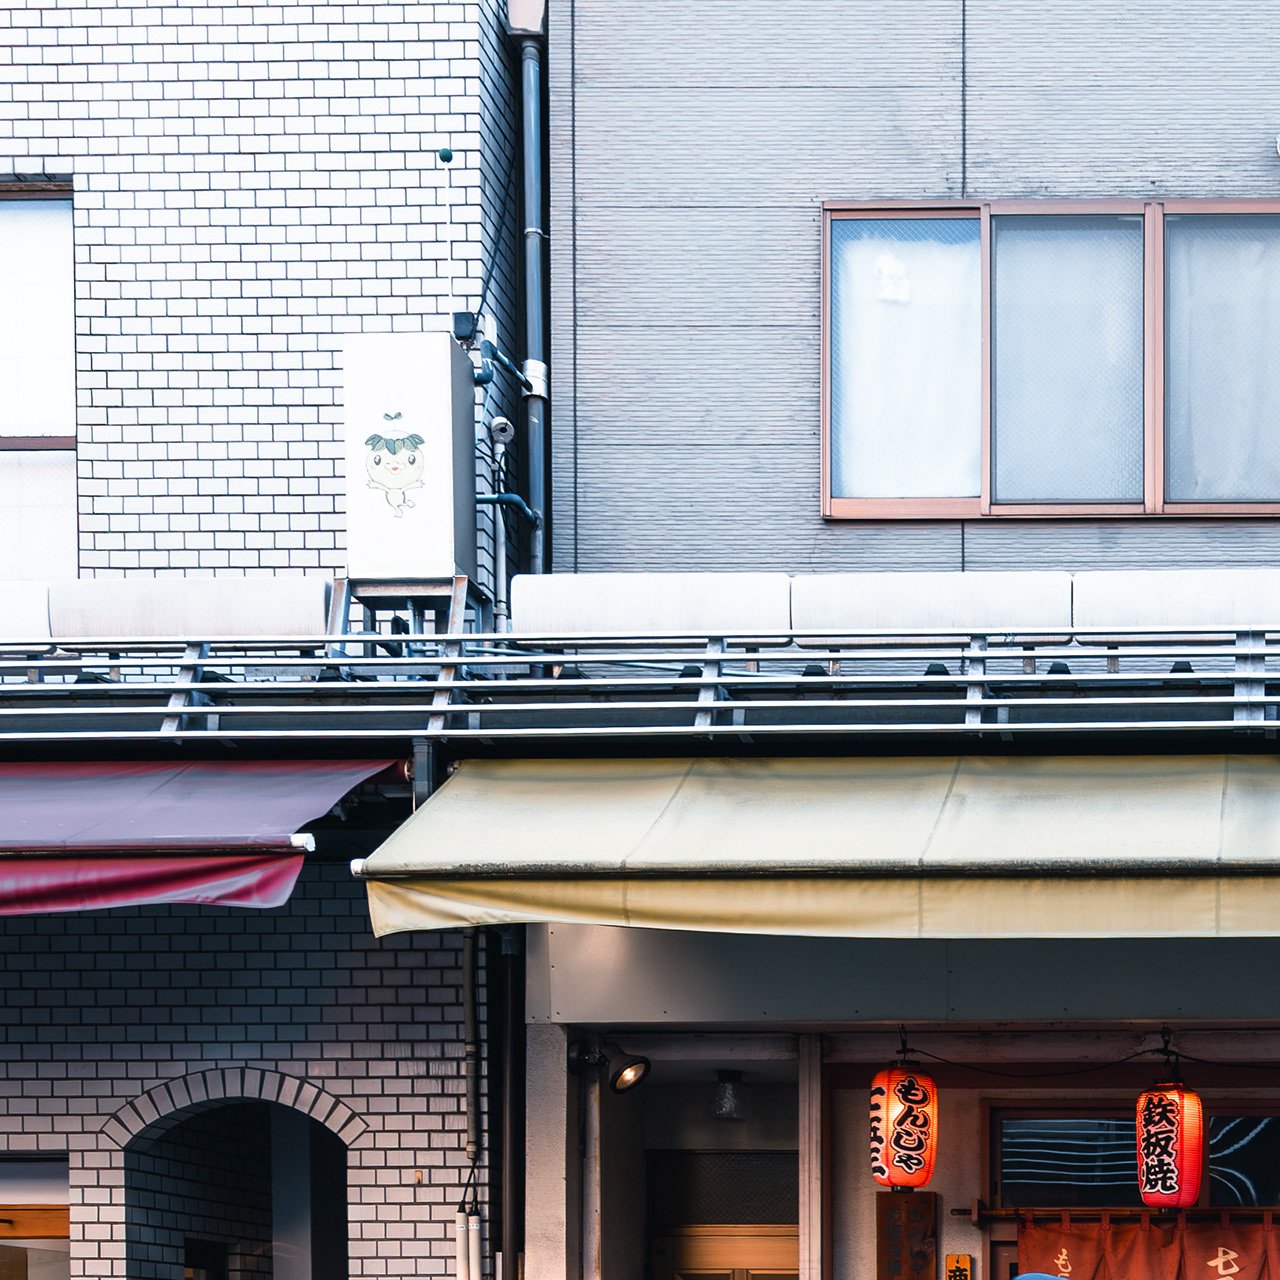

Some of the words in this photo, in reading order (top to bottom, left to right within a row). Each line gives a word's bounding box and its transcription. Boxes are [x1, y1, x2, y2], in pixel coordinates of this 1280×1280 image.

[892, 1076, 930, 1174] もんじゃ
[1141, 1095, 1179, 1194] 鉄板焼
[1054, 1248, 1072, 1277] も
